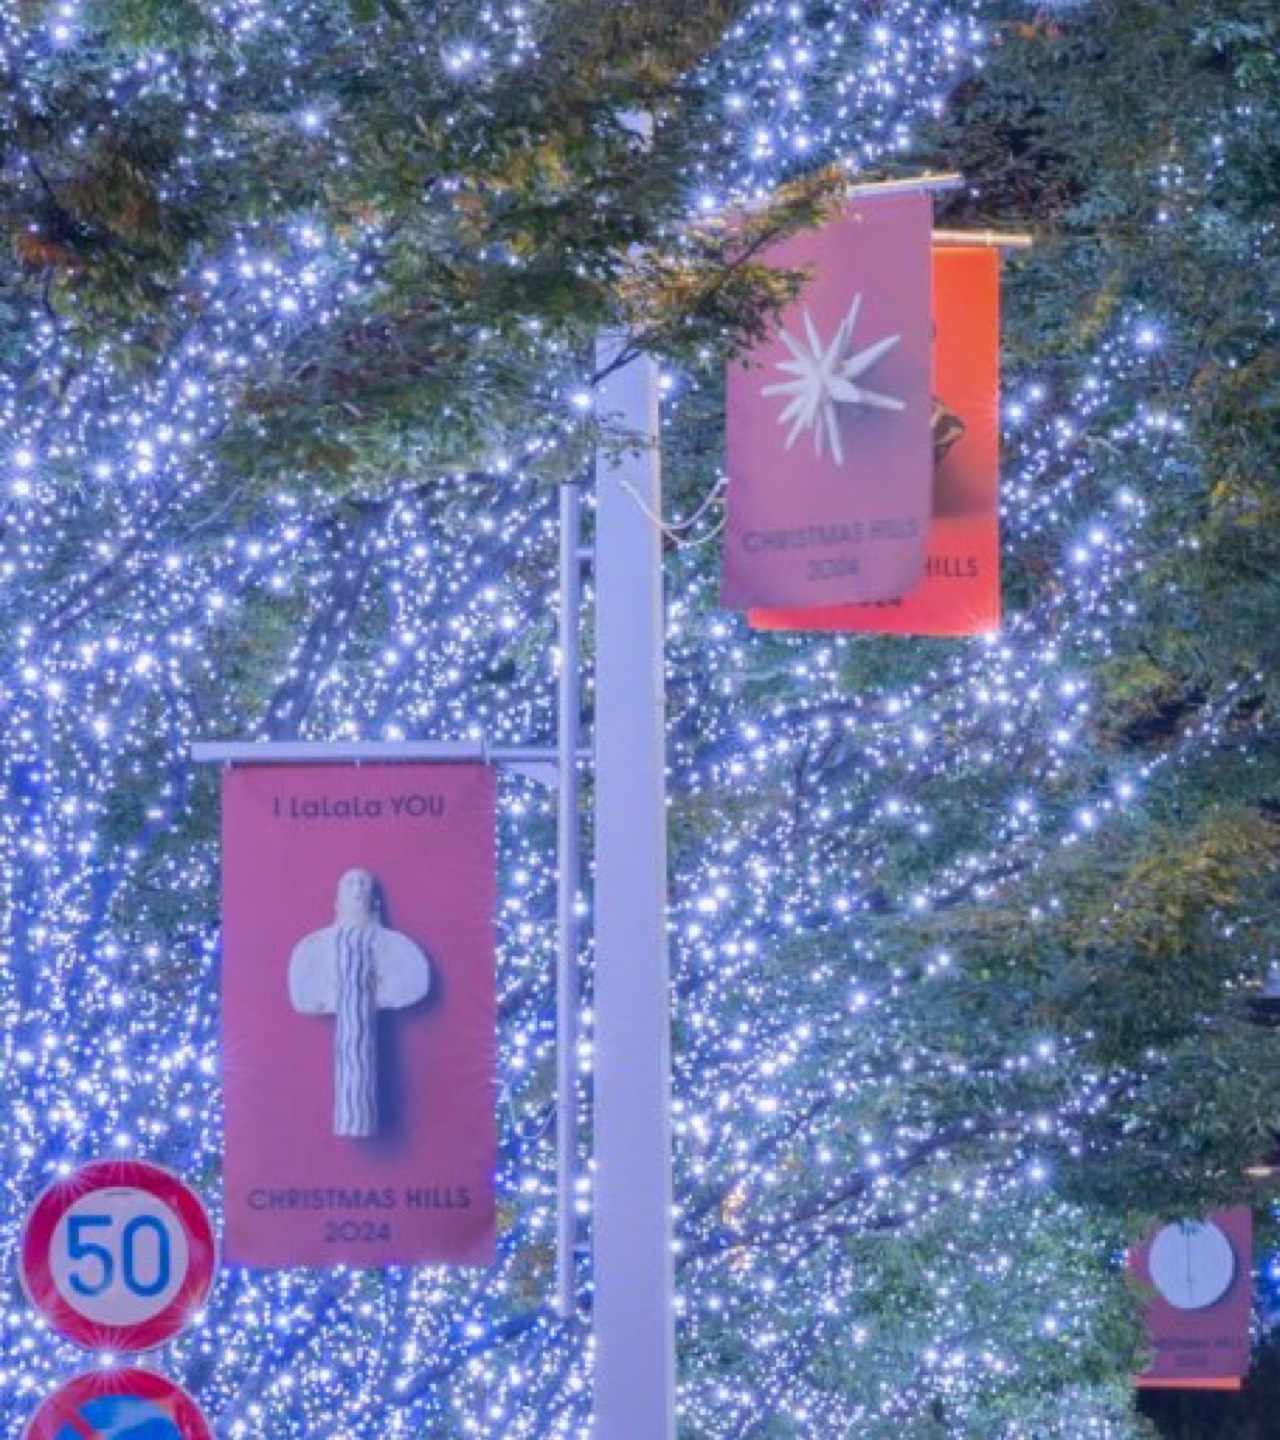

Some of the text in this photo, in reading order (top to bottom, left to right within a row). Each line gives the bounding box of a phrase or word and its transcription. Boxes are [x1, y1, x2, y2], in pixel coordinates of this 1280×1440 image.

[273, 796, 280, 819] I
[389, 793, 445, 817] YOU
[247, 1186, 471, 1210] CHRISTMAS HILLS
[324, 1220, 391, 1243] 2024
[67, 1215, 170, 1297] 50
